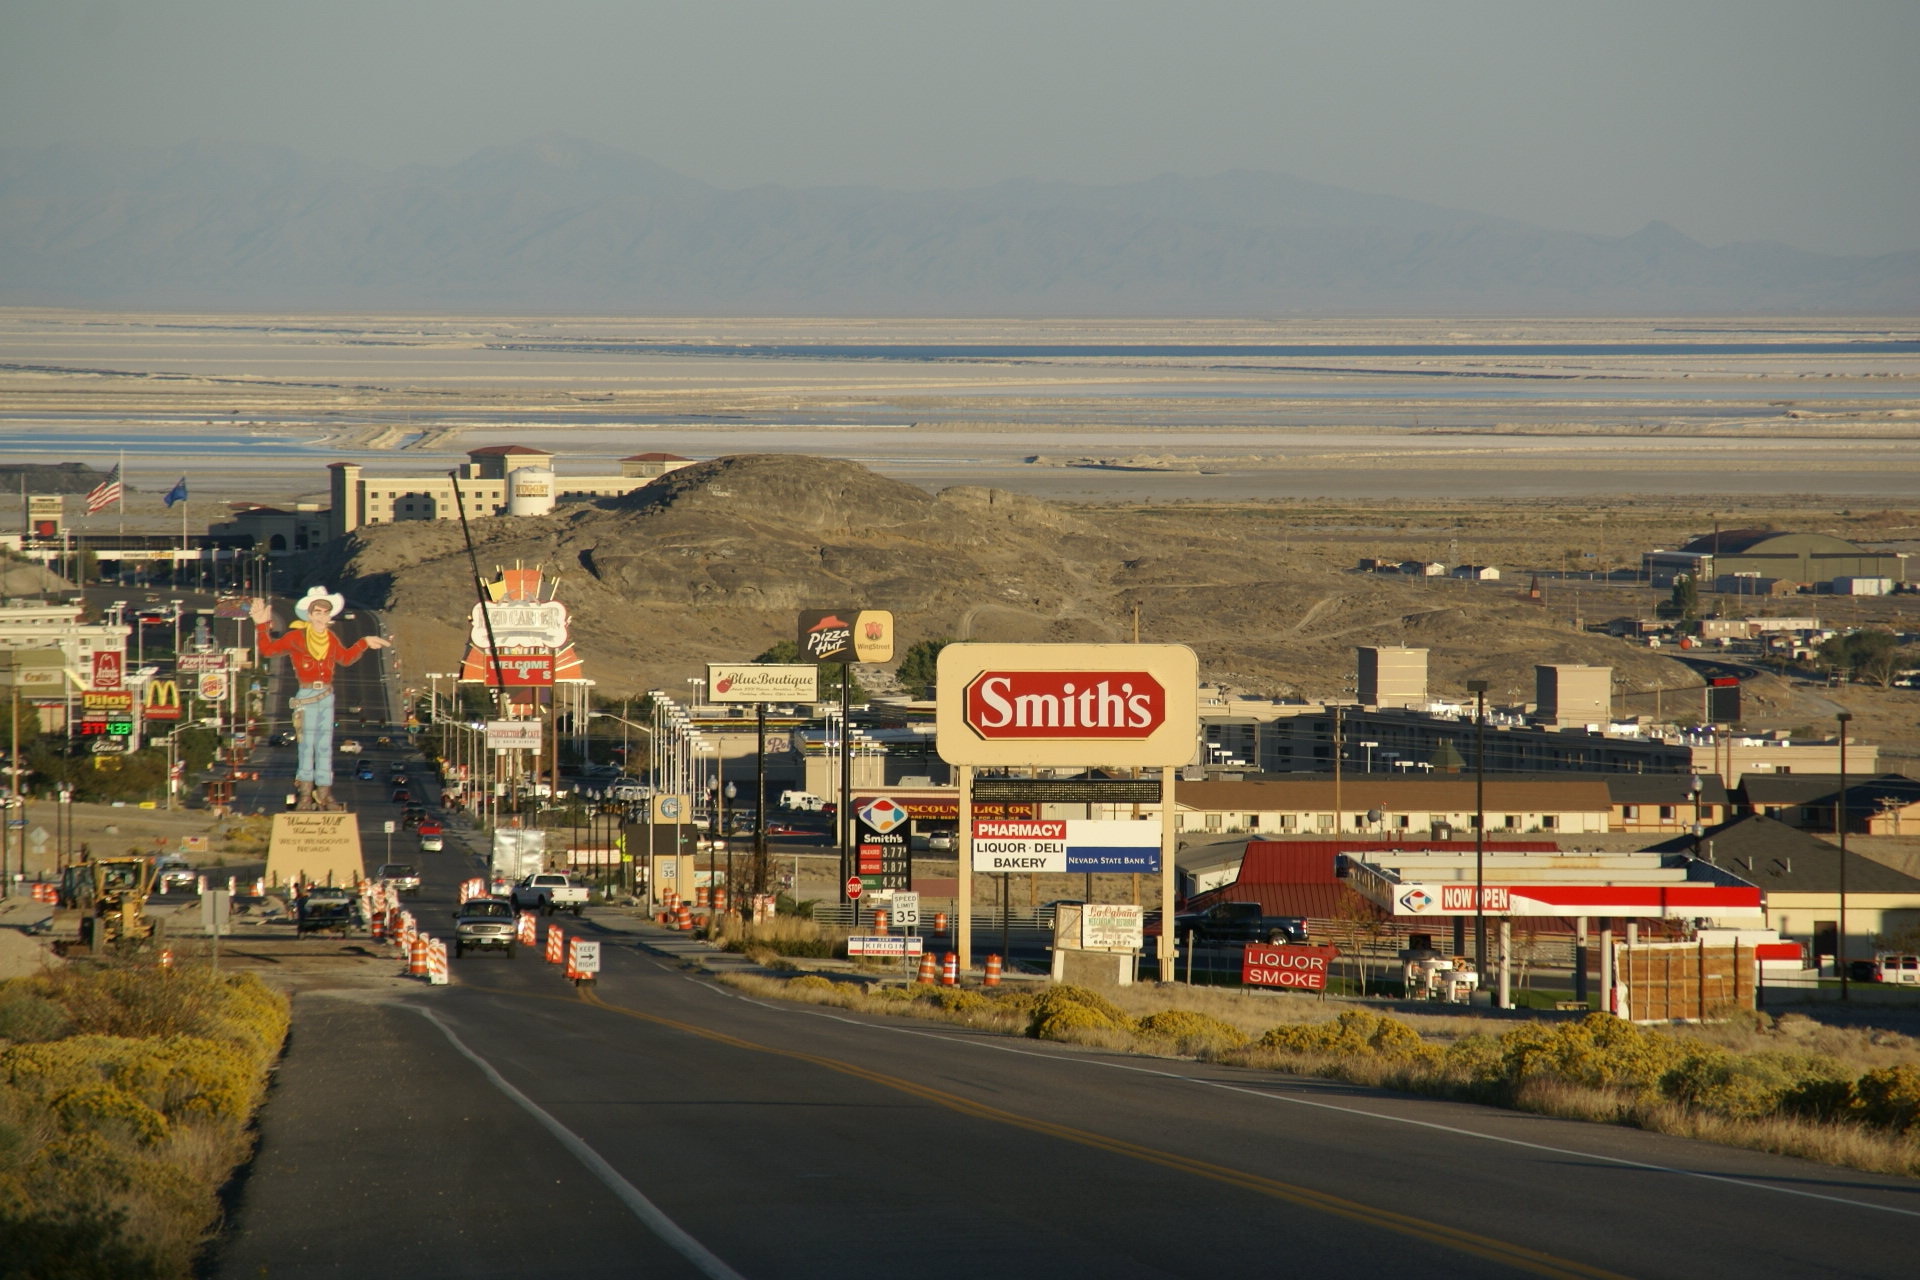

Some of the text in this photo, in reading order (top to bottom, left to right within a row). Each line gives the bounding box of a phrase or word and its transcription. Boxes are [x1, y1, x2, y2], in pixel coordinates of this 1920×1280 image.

[807, 627, 851, 651] Pizza
[815, 639, 846, 656] Hut
[857, 643, 891, 651] WingStreet
[84, 694, 132, 709] Pilot
[980, 677, 1153, 729] Smith's
[902, 805, 959, 813] ISCOUN
[977, 823, 1063, 837] PHARMACY
[863, 834, 904, 844] Smith's
[976, 843, 1064, 855] LIQUOR DELI
[993, 858, 1047, 869] BAKERY
[663, 870, 675, 878] 35
[848, 884, 862, 893] STOP
[1444, 888, 1472, 909] NOW
[896, 910, 917, 923] 35
[579, 945, 597, 953] KEEP
[1247, 951, 1324, 971] LIQUOR
[1249, 969, 1321, 988] SMOKE
